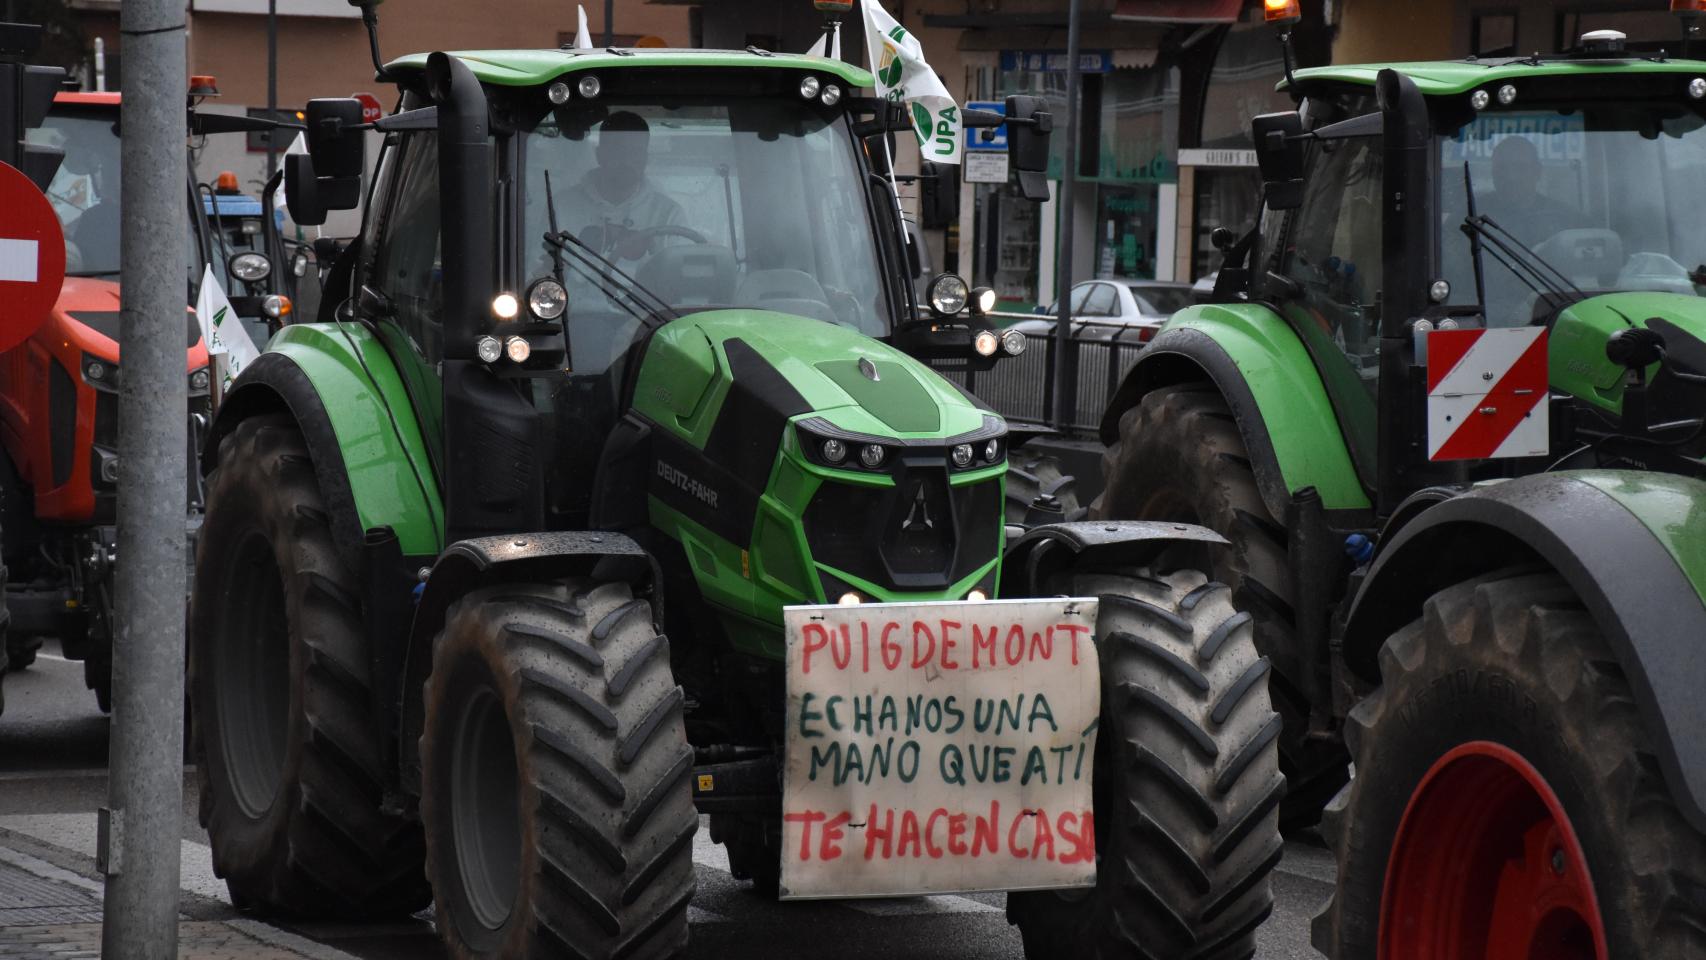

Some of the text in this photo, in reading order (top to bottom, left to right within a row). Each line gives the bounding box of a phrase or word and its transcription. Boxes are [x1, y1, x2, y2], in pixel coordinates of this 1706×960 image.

[362, 107, 379, 118] OP
[934, 105, 958, 156] UPA
[656, 460, 718, 508] DEUTZ-FAHR
[801, 620, 1089, 673] PUIGDEMONT
[800, 693, 1057, 737] ECHANOS UNA
[809, 737, 921, 785] MANO
[784, 809, 851, 861] TE
[864, 800, 1000, 861] HACEN
